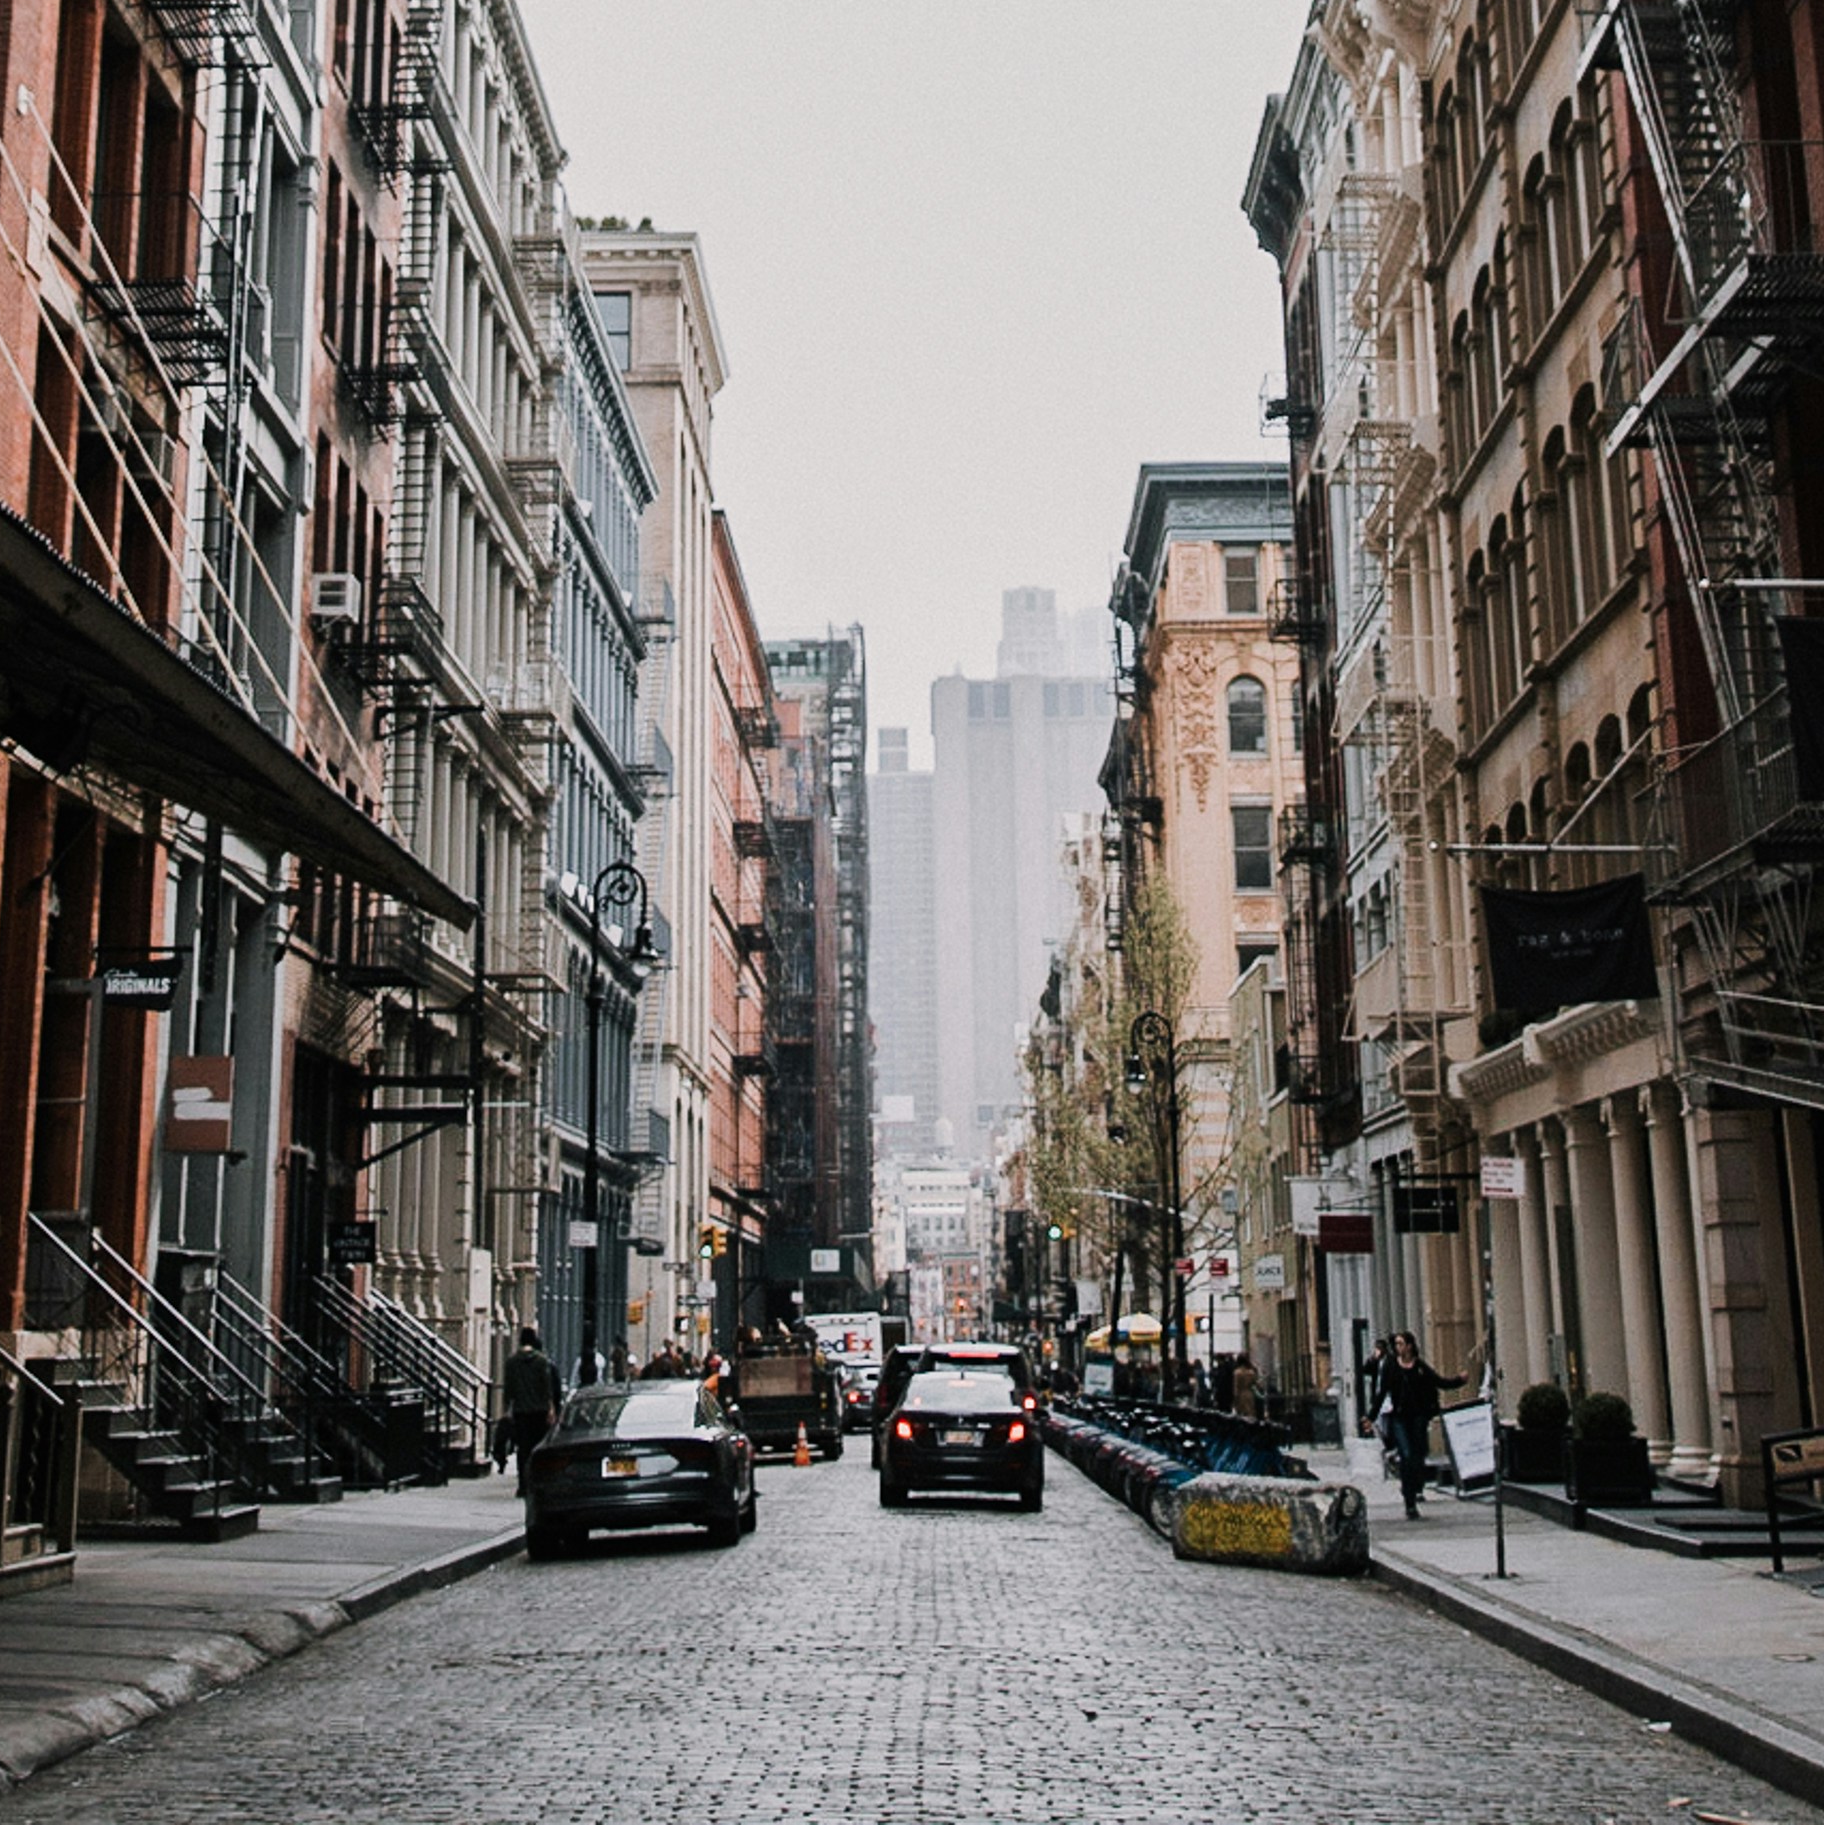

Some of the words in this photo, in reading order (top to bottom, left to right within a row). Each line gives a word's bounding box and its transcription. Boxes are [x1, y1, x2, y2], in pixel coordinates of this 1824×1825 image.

[1517, 933, 1550, 950] rag
[1580, 927, 1624, 943] bone
[819, 1332, 874, 1354] edEx
